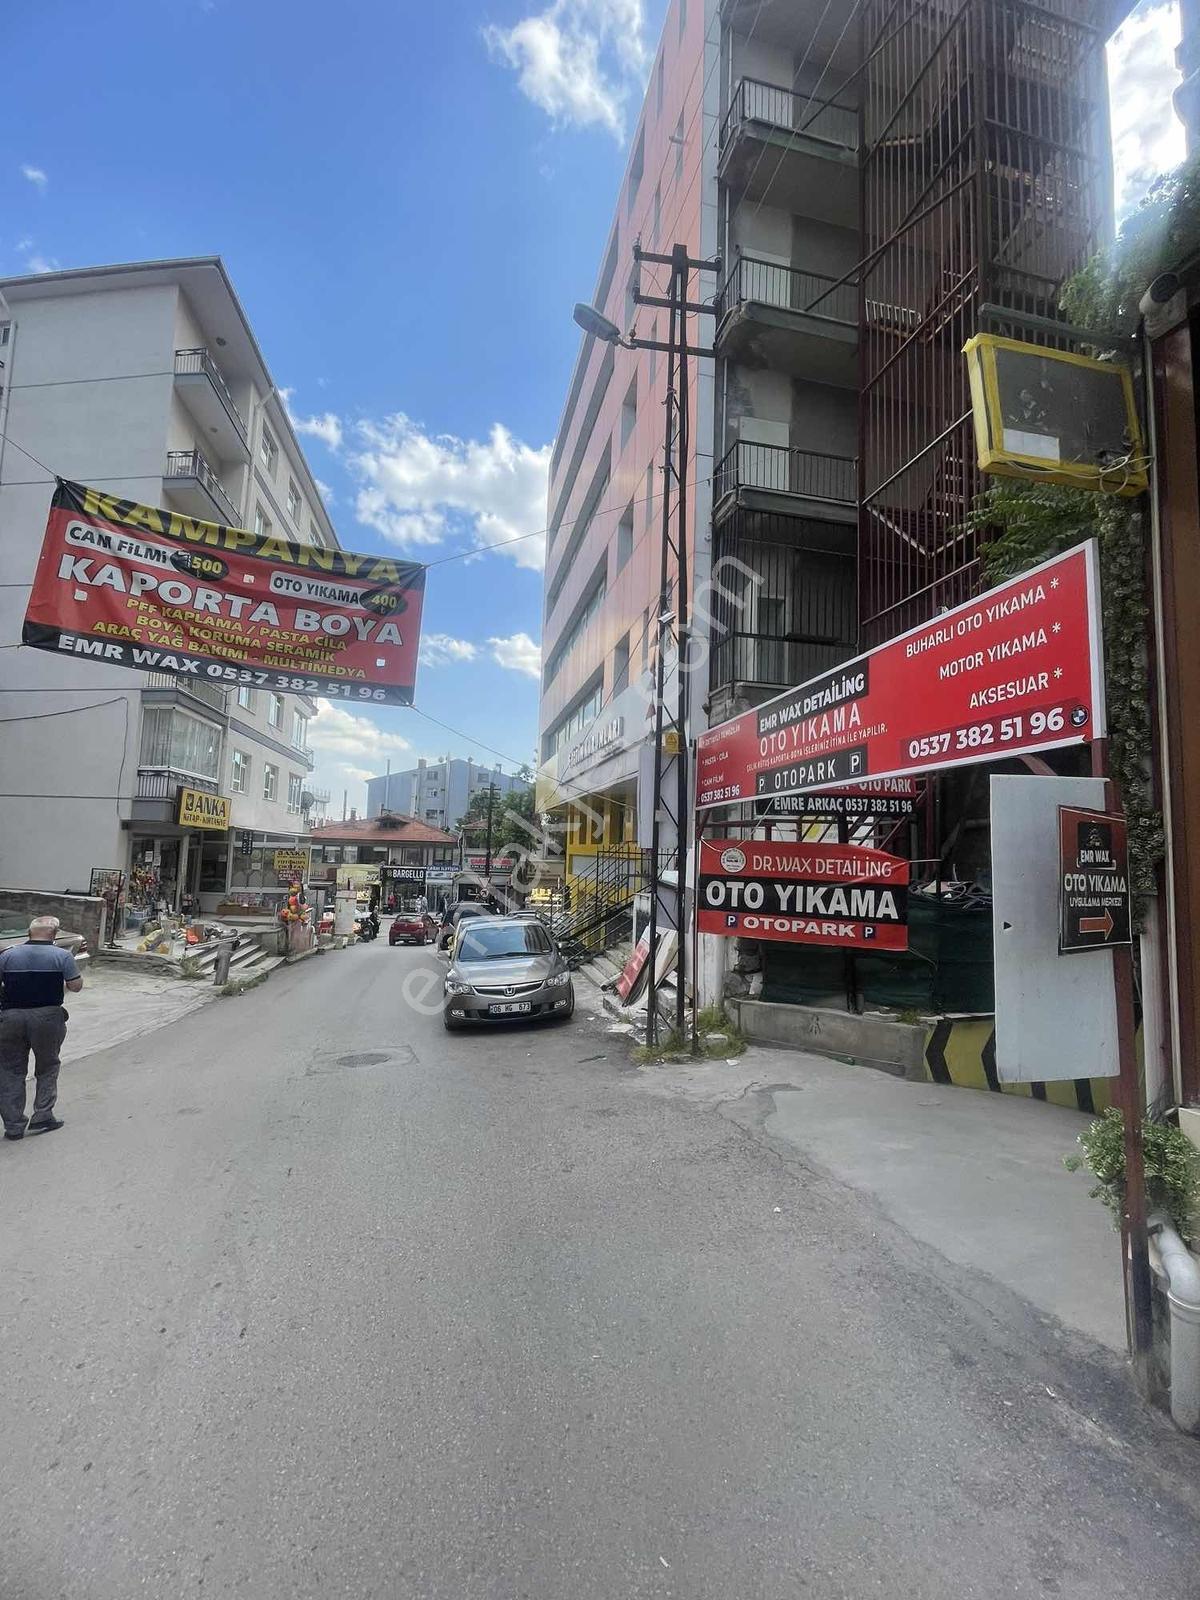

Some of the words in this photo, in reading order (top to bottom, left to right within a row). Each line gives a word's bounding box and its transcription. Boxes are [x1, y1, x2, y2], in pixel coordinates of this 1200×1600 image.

[69, 526, 112, 549] CAM
[117, 540, 167, 564] FİLMİ
[83, 489, 401, 585] KAMPANYA
[58, 553, 280, 627] KAPORTA
[294, 608, 403, 646] BOYA
[273, 576, 302, 593] OTO
[306, 584, 359, 605] YIKAMA
[136, 615, 184, 634] BOYA
[189, 626, 262, 649] KORUMA
[266, 641, 336, 662] SERAMİK
[161, 606, 243, 633] KAPLAMA
[260, 627, 310, 643] PASTA
[314, 635, 348, 651] CİLA
[906, 622, 954, 658] BUHARLI
[957, 612, 983, 636] OTO
[985, 584, 1046, 623] YIKAMA
[58, 634, 123, 660] EMR
[132, 648, 202, 674] WAX
[206, 664, 269, 685] 0537
[275, 675, 319, 693] 382
[327, 683, 350, 697] 51
[358, 687, 386, 700] 96
[93, 621, 143, 641] ARAÇ
[147, 631, 184, 648] YAĞ
[188, 641, 248, 660] BAKIMI
[263, 654, 366, 678] MULTİMEDYA
[939, 651, 984, 680] MOTOR
[986, 628, 1048, 663] YIKAMA
[759, 715, 777, 733] EMR
[779, 701, 802, 724] WAX
[803, 673, 865, 714] DETAİLİNG
[968, 672, 1049, 710] AKSESUAR
[760, 729, 787, 757] OTO
[791, 702, 861, 747] YIKAMA
[908, 732, 951, 759] 0537
[956, 723, 994, 750] 382
[1000, 716, 1023, 741] 51
[1029, 707, 1065, 735] 96
[774, 758, 836, 789] OTOPARK
[885, 778, 912, 793] PARK
[774, 797, 805, 811] EMRE
[807, 798, 844, 813] ARKAÇ
[845, 798, 868, 812] 0537
[871, 799, 887, 812] 382
[889, 800, 900, 812] 51
[901, 800, 913, 813] 96
[392, 869, 424, 879] BARGELLO
[1080, 850, 1094, 863] EMR
[1094, 850, 1110, 863] WAX
[705, 880, 765, 909] OTO
[774, 883, 899, 920] YIKAMA
[1064, 873, 1087, 892] OTO
[1088, 874, 1127, 893] YIKAMA
[743, 916, 856, 937] OTOPARK
